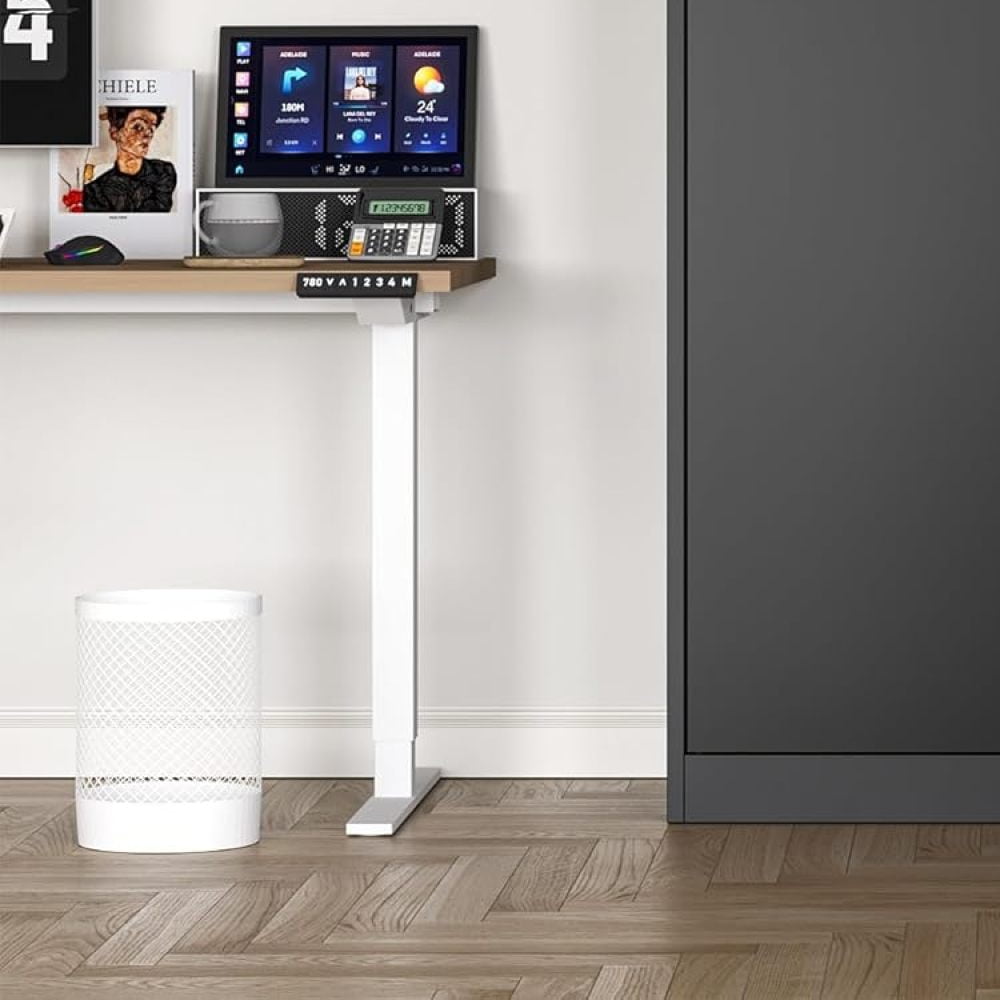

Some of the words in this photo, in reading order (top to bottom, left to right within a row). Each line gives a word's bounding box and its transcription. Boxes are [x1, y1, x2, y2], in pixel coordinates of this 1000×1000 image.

[281, 103, 305, 112] 180M
[302, 277, 323, 287] 780
[364, 277, 371, 287] 2
[376, 277, 384, 287] 3
[388, 277, 396, 287] 4
